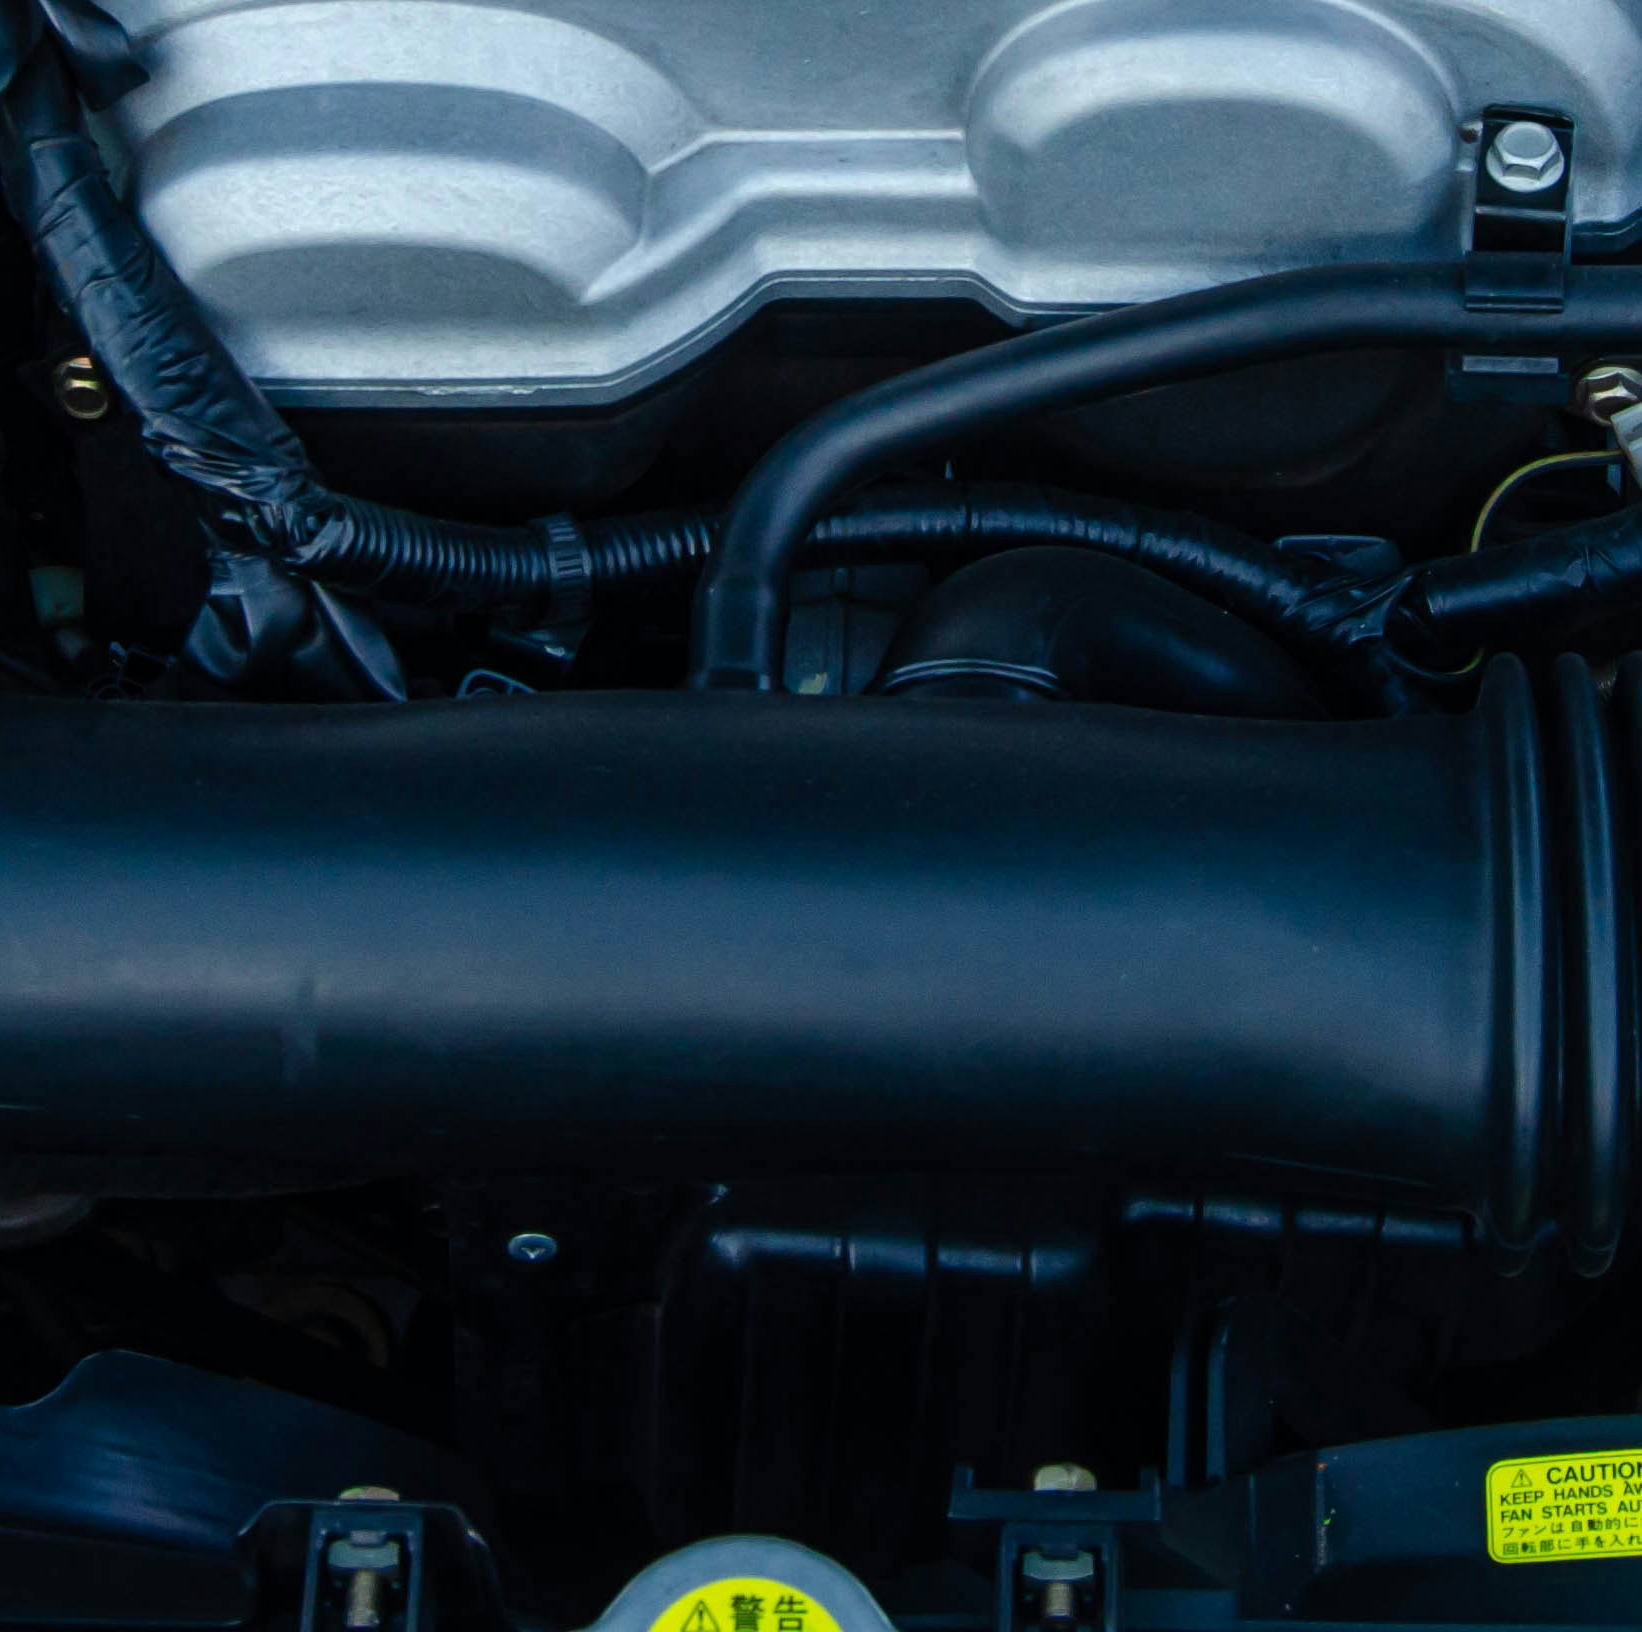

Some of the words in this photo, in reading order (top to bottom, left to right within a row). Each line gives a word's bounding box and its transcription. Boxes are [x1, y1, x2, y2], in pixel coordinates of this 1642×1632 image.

[1499, 1490, 1544, 1506] KEEP
[1553, 1484, 1613, 1501] HANDS
[1500, 1508, 1533, 1523] FAN
[1542, 1502, 1608, 1520] STARTS
[729, 1593, 808, 1632] 警告
